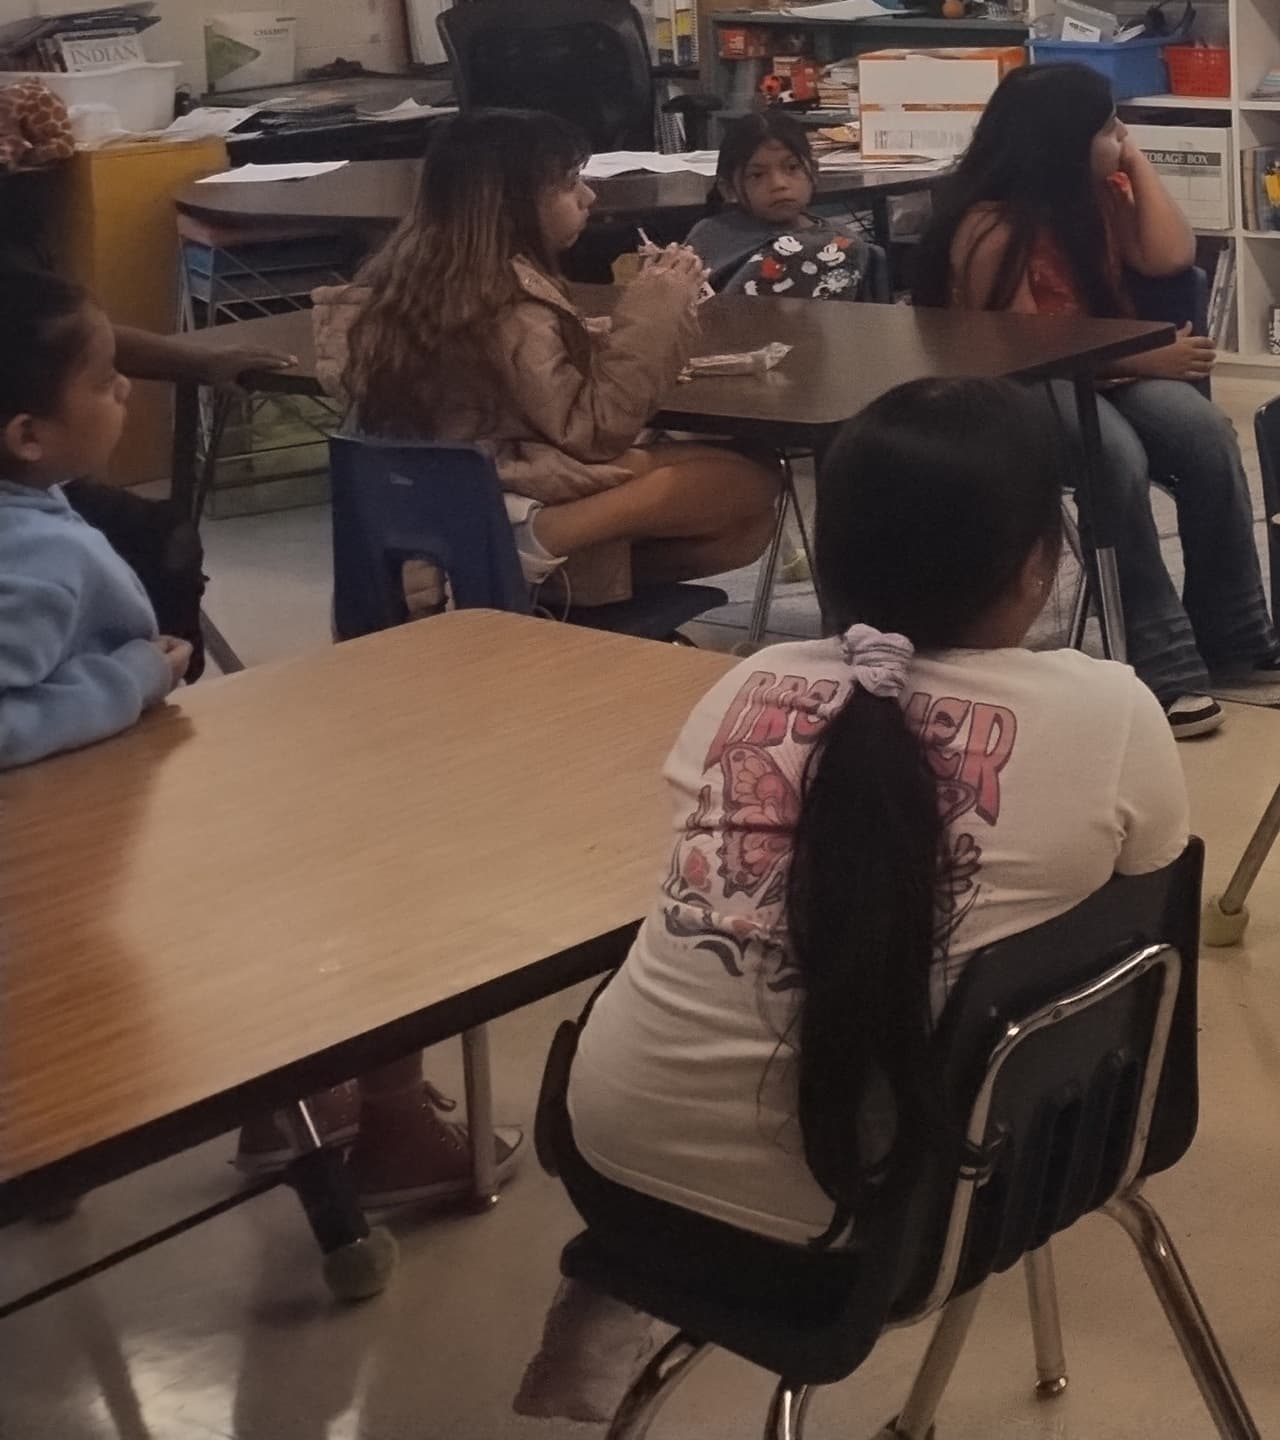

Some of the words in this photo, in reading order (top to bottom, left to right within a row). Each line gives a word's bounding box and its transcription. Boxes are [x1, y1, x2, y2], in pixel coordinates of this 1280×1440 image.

[70, 44, 139, 66] INDIAN
[1144, 151, 1185, 164] TORAGE
[1187, 153, 1209, 165] BOX
